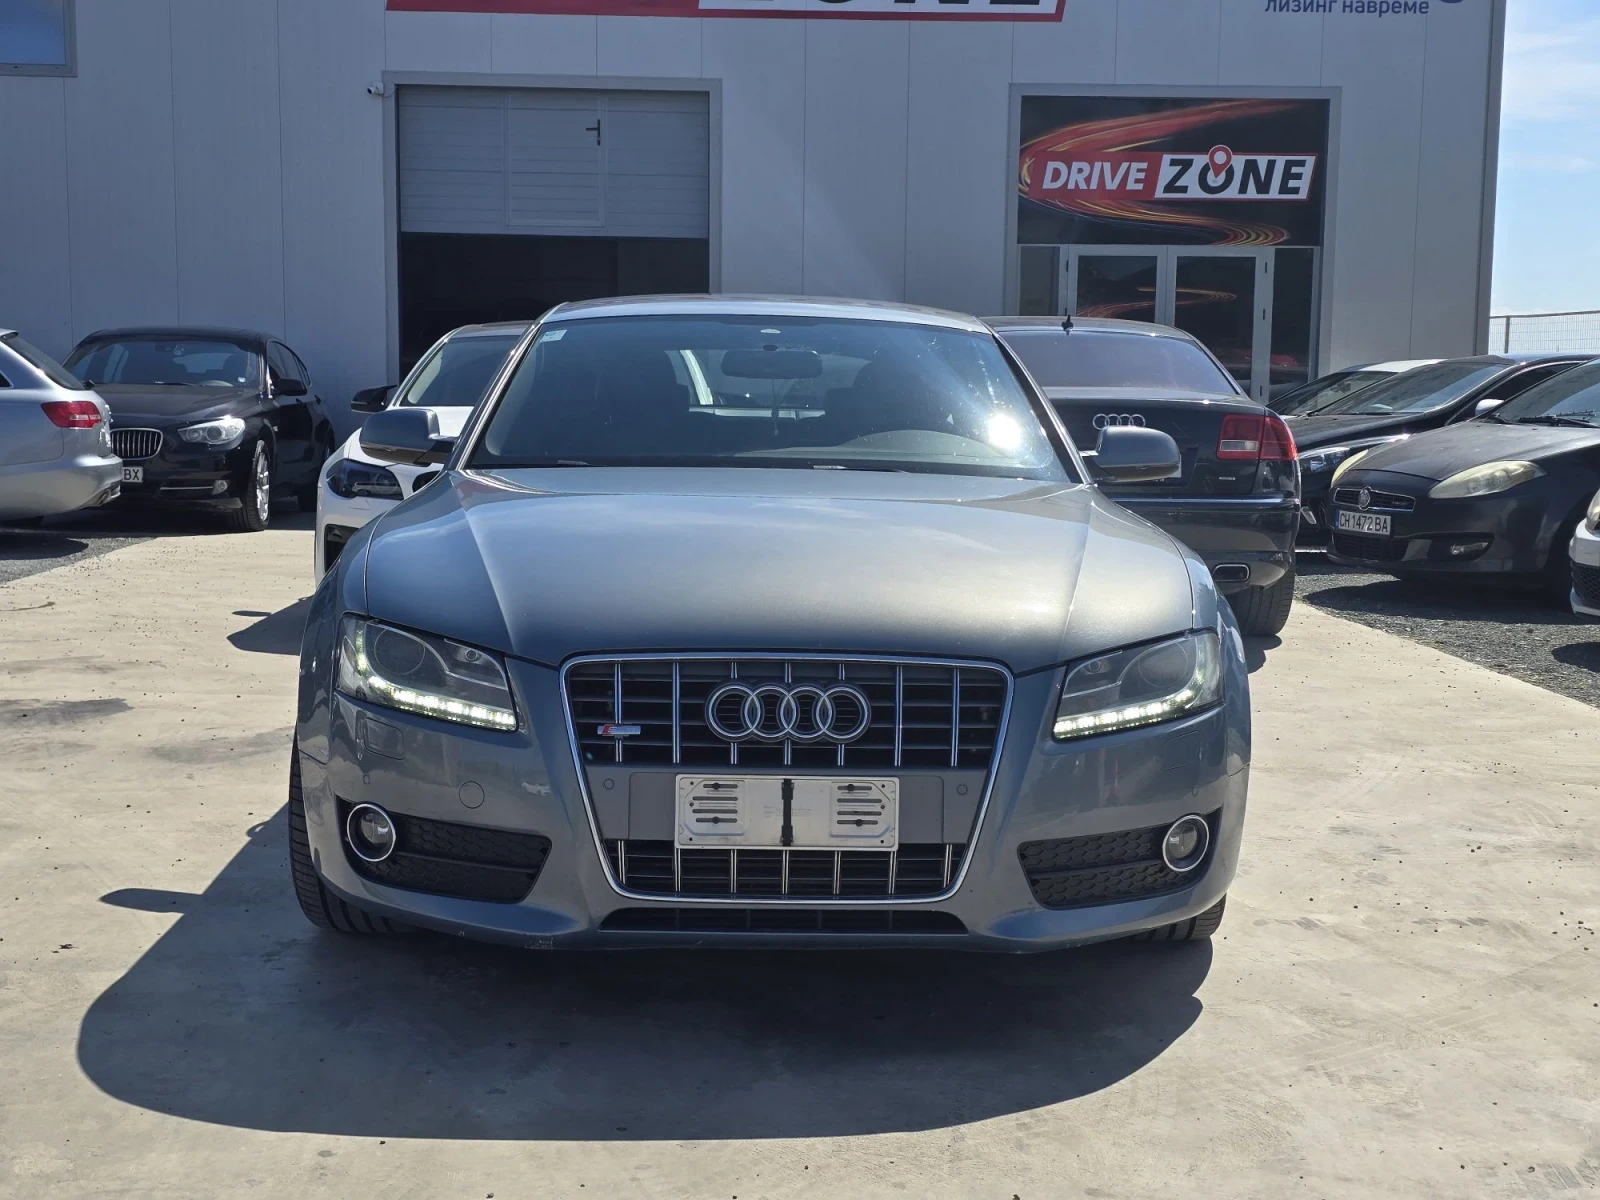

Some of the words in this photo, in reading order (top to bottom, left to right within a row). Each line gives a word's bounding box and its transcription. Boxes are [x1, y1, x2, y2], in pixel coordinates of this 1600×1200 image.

[1265, 0, 1337, 12] лизинг
[1342, 0, 1429, 17] навреме
[1042, 161, 1148, 190] DRIVE
[1162, 158, 1306, 195] ZONE
